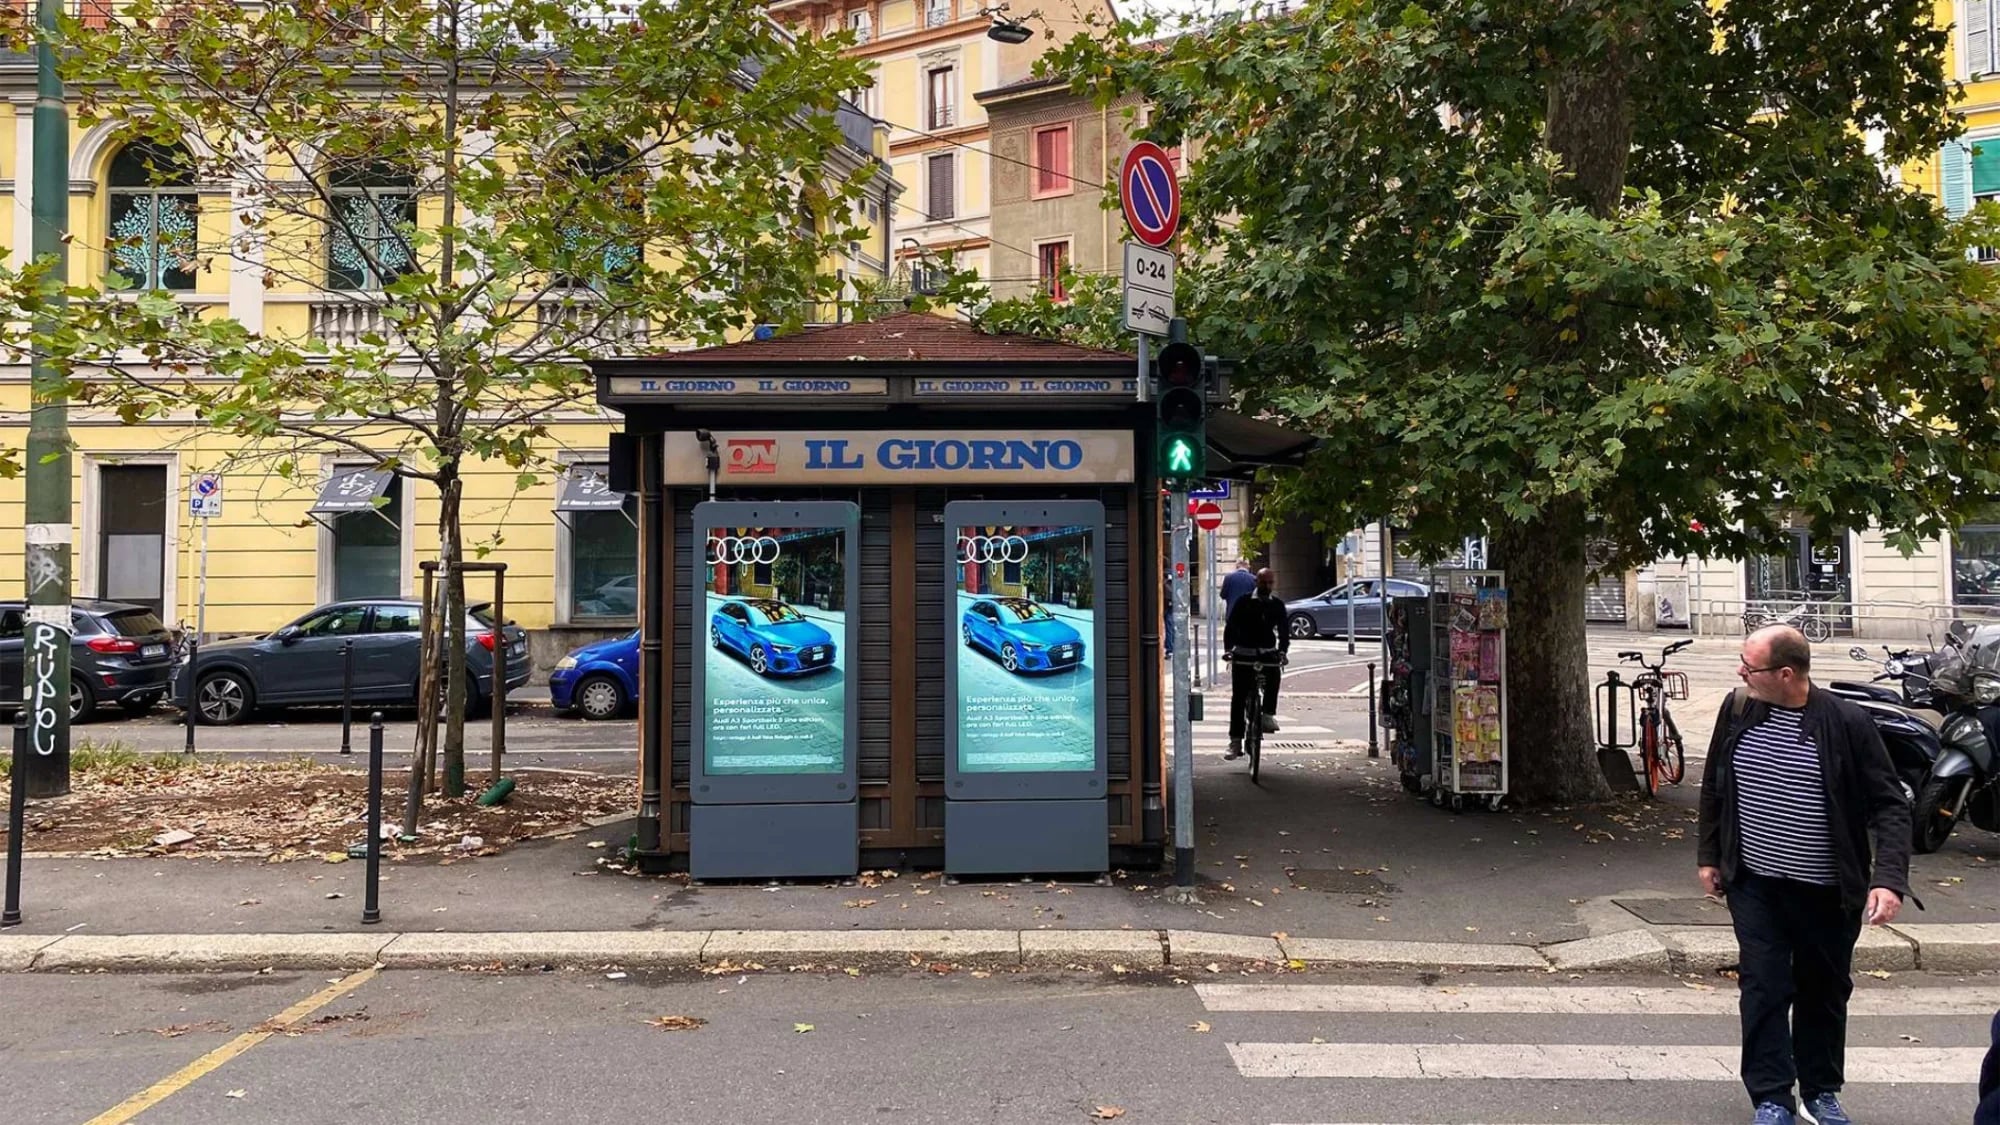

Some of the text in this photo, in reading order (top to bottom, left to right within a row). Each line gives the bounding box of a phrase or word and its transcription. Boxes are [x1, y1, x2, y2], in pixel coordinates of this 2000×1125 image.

[1136, 258, 1167, 281] 0-24
[640, 380, 851, 392] IL GIORNO IL GIORNO
[918, 381, 938, 392] IL
[942, 381, 1010, 392] GIORNO
[1020, 381, 1040, 391] IL
[1043, 381, 1111, 392] GIORNO
[727, 443, 779, 470] QN
[804, 438, 1083, 471] IL GIORNO
[801, 697, 829, 705] unica,
[713, 706, 784, 714] personalizzata.
